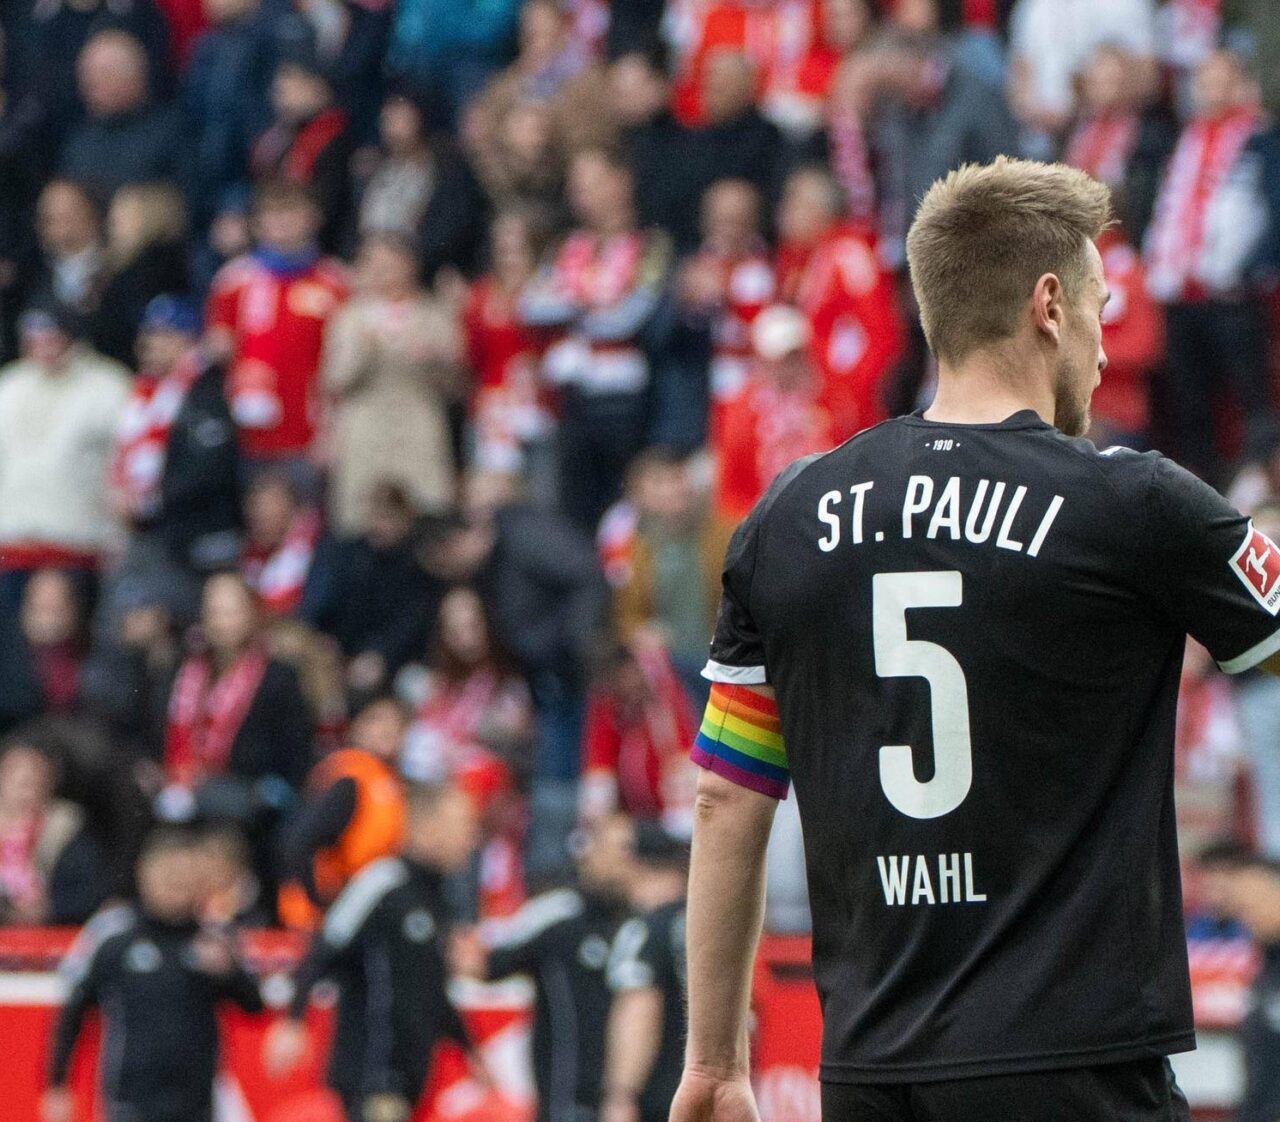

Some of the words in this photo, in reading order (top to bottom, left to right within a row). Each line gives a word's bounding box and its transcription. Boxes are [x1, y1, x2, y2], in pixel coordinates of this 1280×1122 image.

[932, 439, 954, 451] 1910
[817, 481, 884, 552] ST.
[902, 475, 1064, 557] PAULI
[872, 570, 973, 820] 5
[876, 852, 988, 906] WAHL
